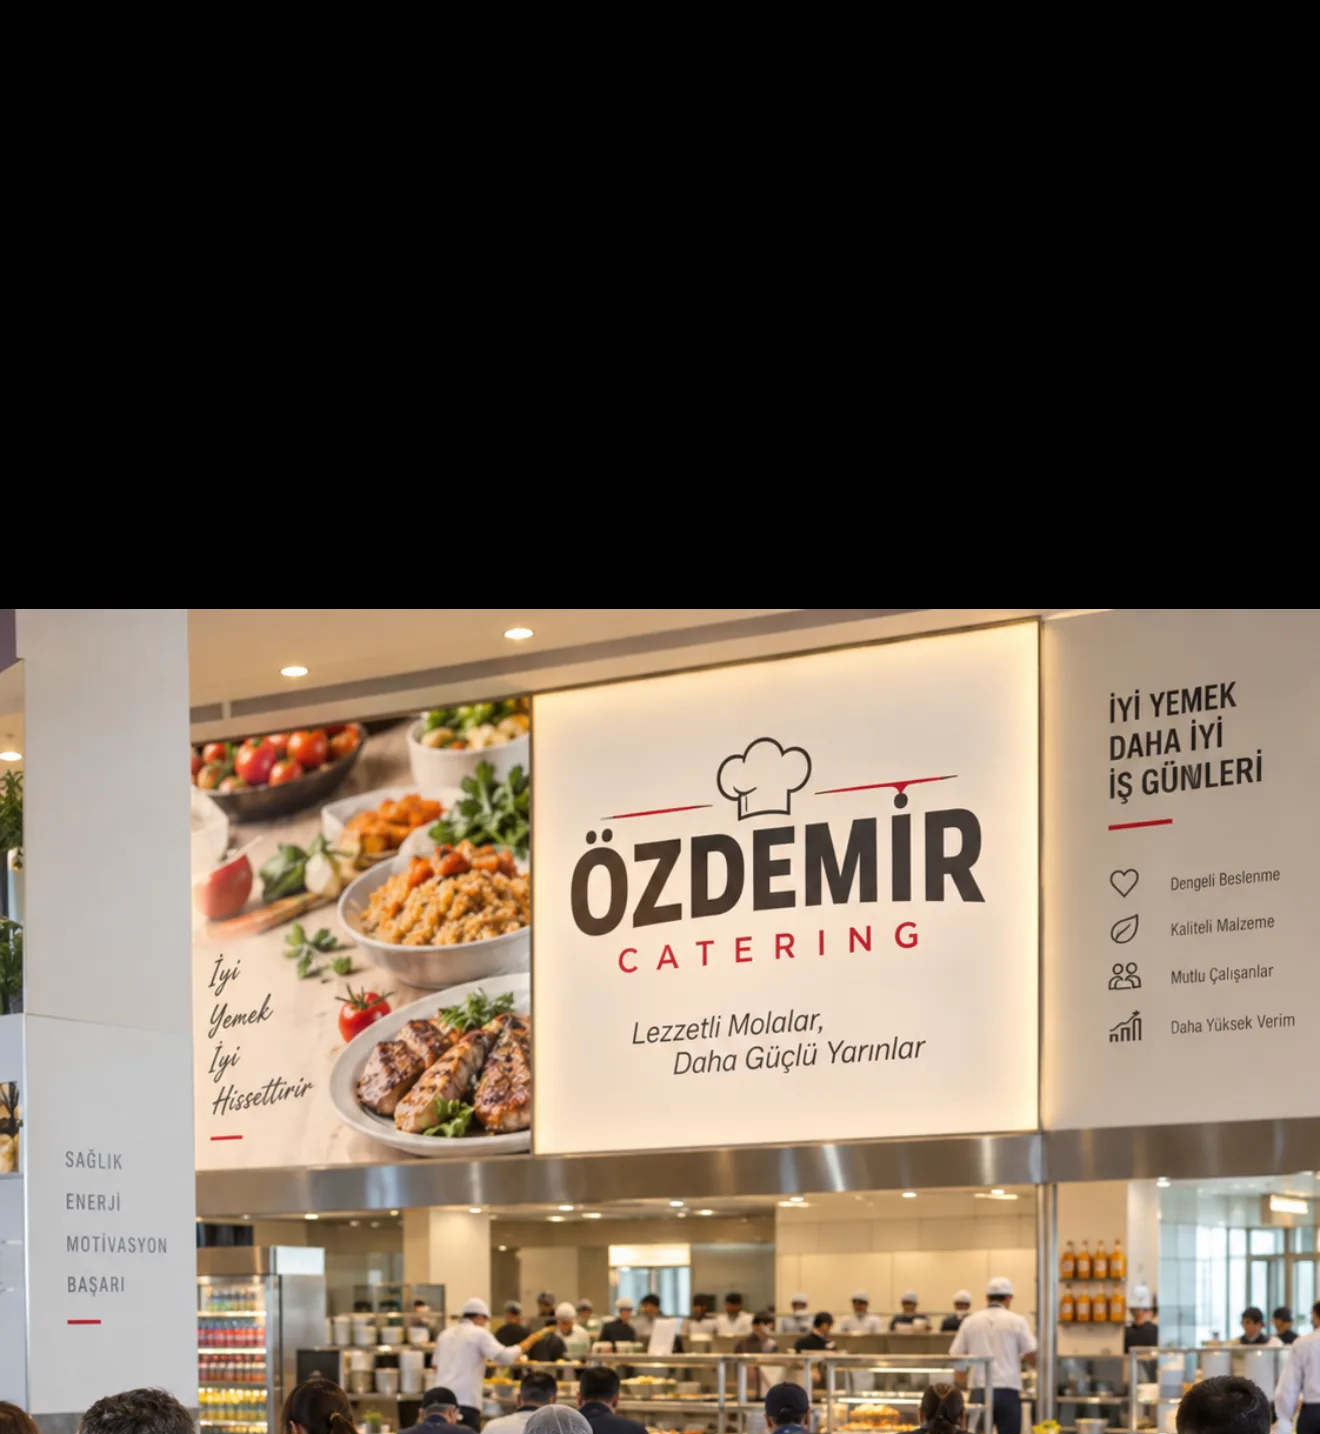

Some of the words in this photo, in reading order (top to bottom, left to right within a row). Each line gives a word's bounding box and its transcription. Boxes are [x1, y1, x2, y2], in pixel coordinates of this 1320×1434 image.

[1109, 689, 1140, 724] İYİ
[1149, 681, 1237, 718] YEMEK
[1109, 728, 1182, 761] DAHA
[1190, 716, 1224, 752] İYİ
[1109, 767, 1134, 804] İŞ
[570, 793, 986, 937] ÖZDEMİR
[1170, 873, 1215, 892] Dengeli
[1219, 870, 1281, 887] Beslenme
[1170, 919, 1213, 937] Kaliteli
[1216, 917, 1275, 933] Malzeme
[617, 921, 919, 974] CATERING
[208, 953, 241, 997] İyi
[1170, 968, 1206, 985] Mutlu
[1209, 964, 1274, 985] Çalışanlar
[207, 993, 274, 1039] Yemek
[632, 1015, 722, 1045] Lezzetli
[728, 1009, 825, 1038] Molalar,
[1170, 1019, 1203, 1035] Daha
[1206, 1015, 1253, 1032] Yüksek
[1256, 1012, 1295, 1029] Verim
[208, 1040, 241, 1083] İyi
[673, 1048, 738, 1076] Daha
[745, 1042, 818, 1074] Güçlü
[827, 1036, 926, 1063] Yarınlar
[65, 1148, 124, 1171] SAĞLIK
[66, 1191, 121, 1212] ENERJİ
[66, 1233, 168, 1254] MOTİVASYON
[67, 1275, 125, 1297] BAŞARI
